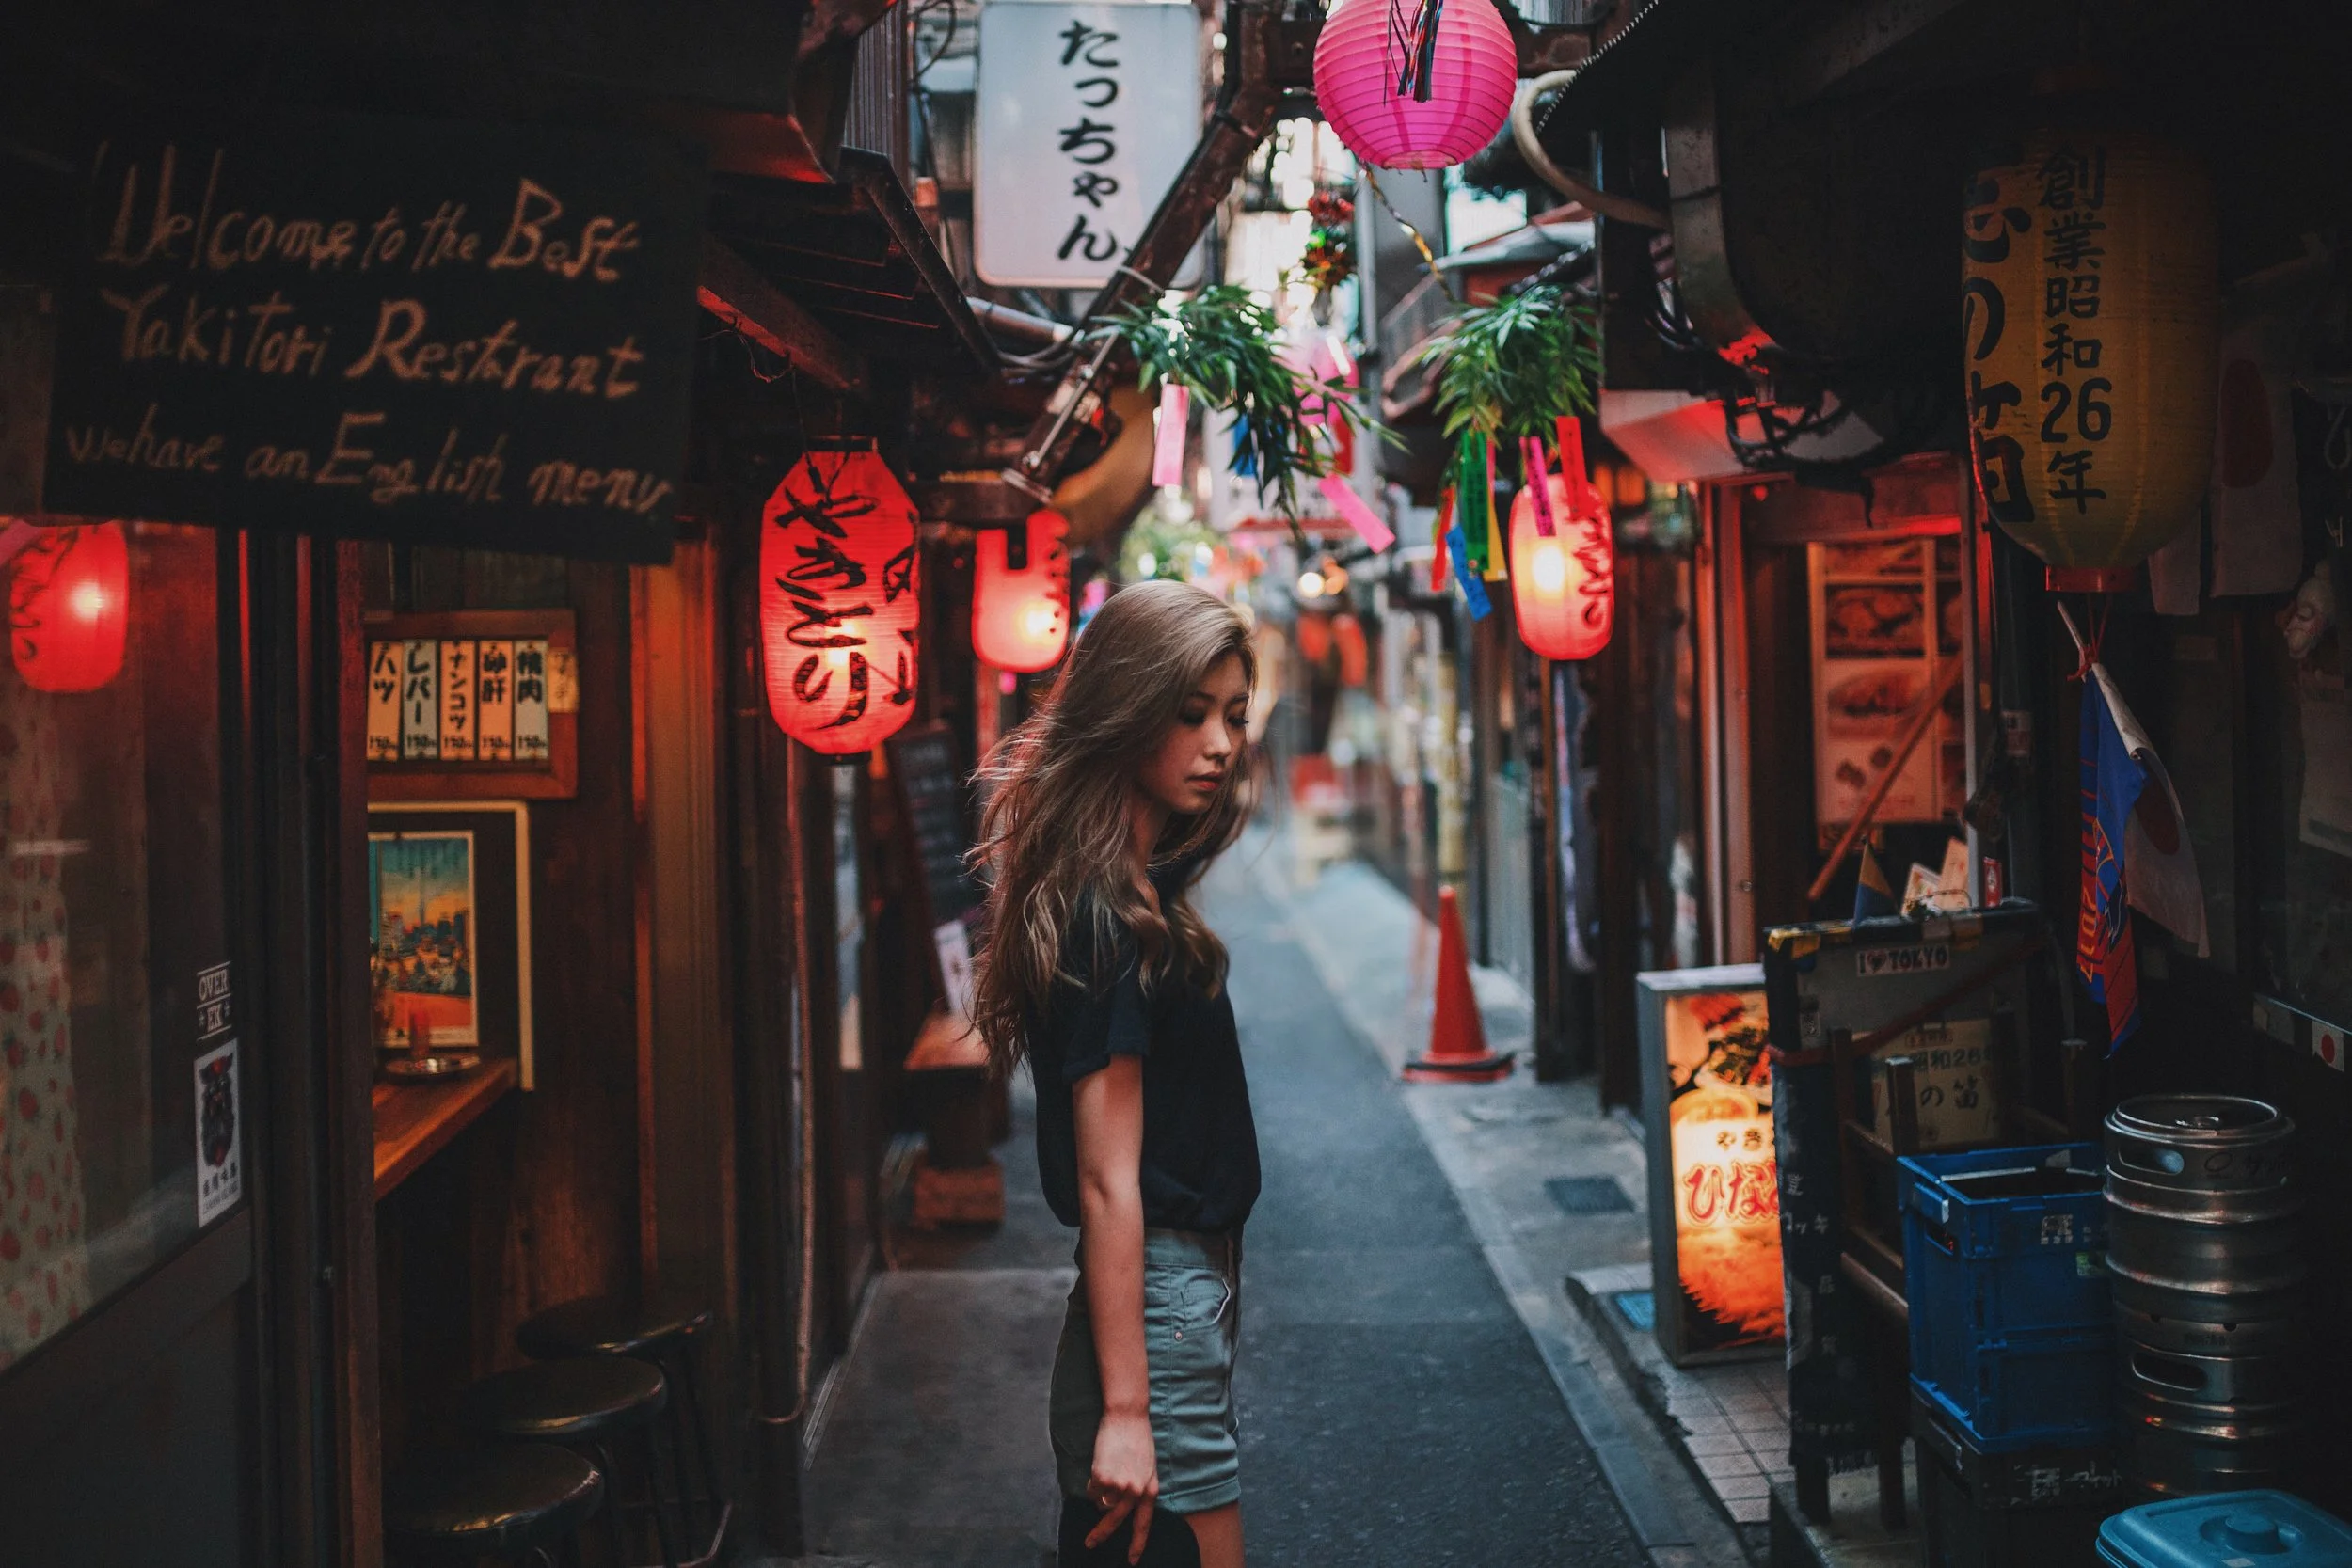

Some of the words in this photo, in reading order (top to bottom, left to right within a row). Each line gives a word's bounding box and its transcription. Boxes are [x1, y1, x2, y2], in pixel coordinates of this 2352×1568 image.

[1057, 19, 1120, 262] たっちゃん
[93, 140, 358, 271] Welcome
[359, 202, 406, 271] to
[411, 199, 481, 272] the
[485, 176, 641, 281] Best
[2036, 144, 2113, 515] 創業昭和26年
[242, 444, 310, 480] an
[314, 411, 510, 505] English
[406, 648, 431, 724] レバー
[1859, 952, 1867, 974] I
[1888, 944, 1948, 971] TOKYO
